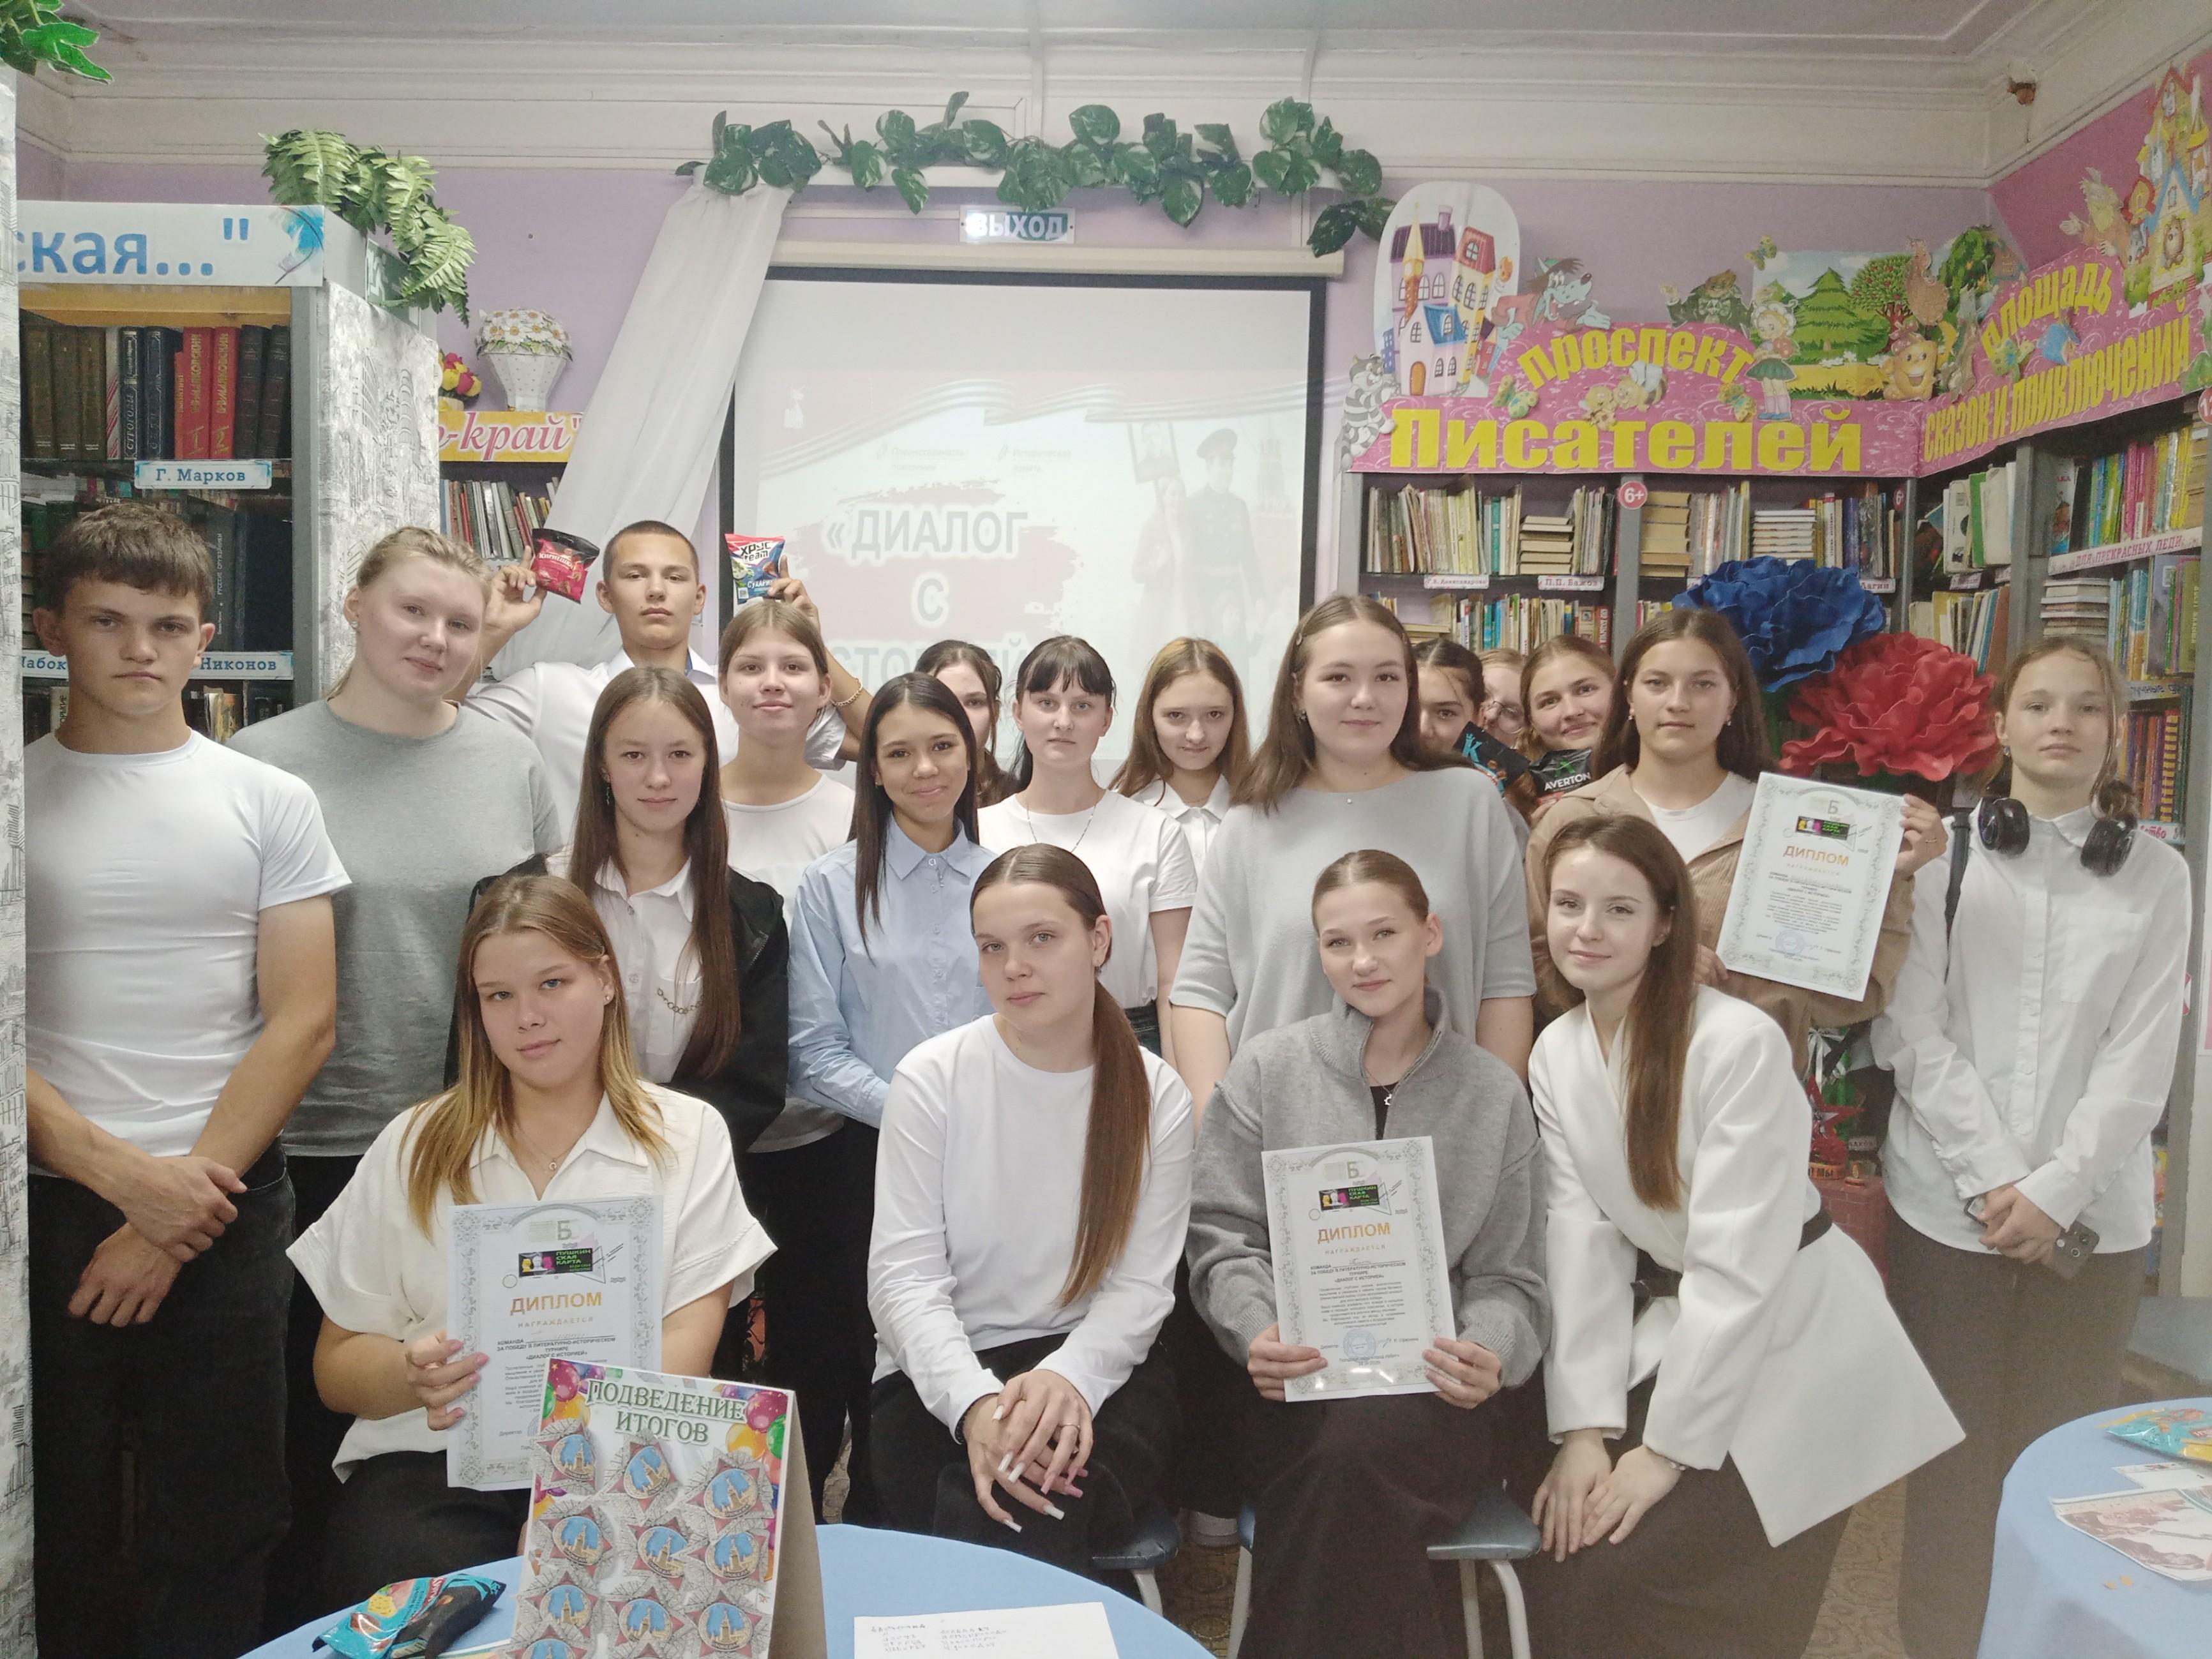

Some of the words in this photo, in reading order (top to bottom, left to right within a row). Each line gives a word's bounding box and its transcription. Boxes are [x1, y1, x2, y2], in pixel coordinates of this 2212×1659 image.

[965, 211, 1066, 240] ВЫХОД
[2200, 395, 2212, 417] 1
[1388, 407, 1862, 473] Писателей
[156, 468, 172, 482] Г.
[177, 468, 246, 485] Марков
[1623, 488, 1646, 504] 6+
[2096, 541, 2153, 562] ПРЕКРАСНЫХ
[2155, 535, 2183, 551] ЛЕДИ
[200, 657, 277, 671] Никонов
[1544, 772, 1591, 792] AVERTON
[1782, 845, 1849, 867] ДИПЛОМ
[1317, 1222, 1391, 1244] ДИПЛОМ
[510, 1291, 603, 1316] ДИПЛОМ
[518, 1316, 594, 1328] НАГРАЖДАЕТСЯ
[586, 1381, 746, 1422] ПОДВЕДЕНИЕ
[616, 1411, 709, 1443] ИТОГОВ
